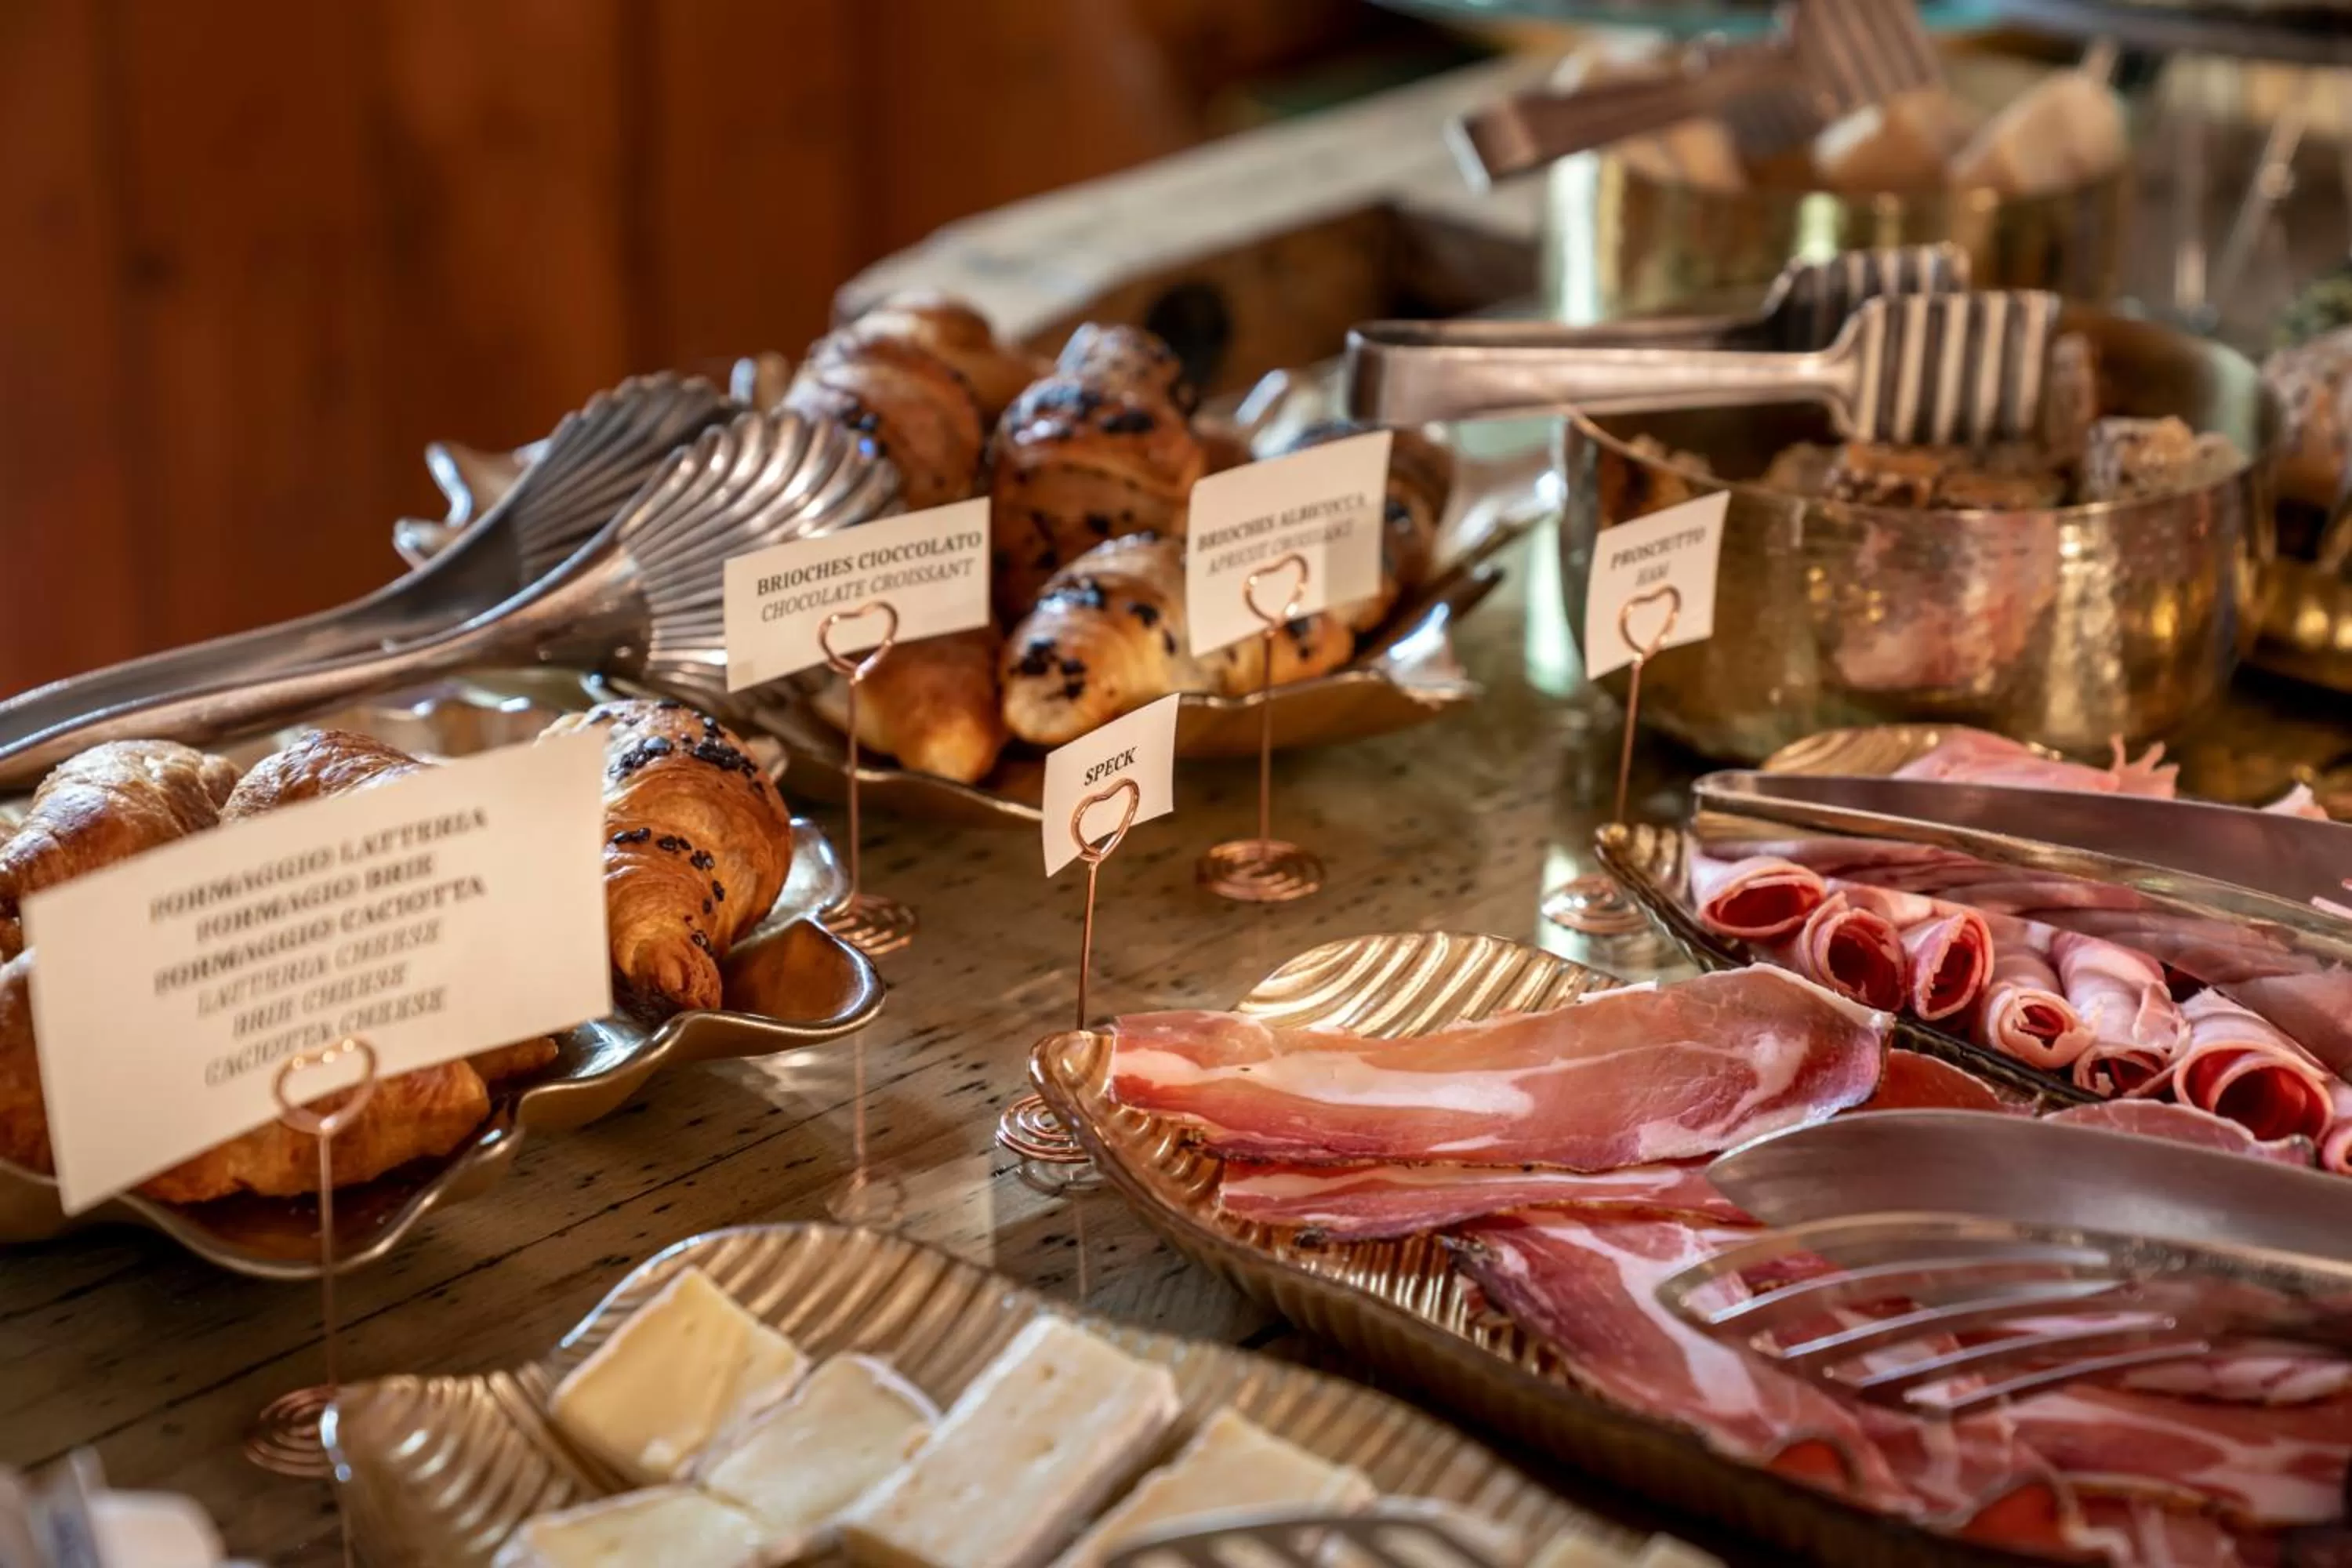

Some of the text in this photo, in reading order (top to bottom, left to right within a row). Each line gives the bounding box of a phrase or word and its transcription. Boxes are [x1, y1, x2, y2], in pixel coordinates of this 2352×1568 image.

[757, 531, 983, 596] BRIOCHES CIOCCOLATO
[1196, 514, 1276, 552] BRIOCHES
[761, 557, 975, 622] CHOCOLATE CROISSANT
[1083, 745, 1138, 786] SPECK
[148, 808, 488, 924] FORMAGGIO LATTERIA
[364, 853, 436, 893] BRIE
[153, 874, 487, 996] FORMAGGIO CACIOTTA
[198, 916, 443, 1018] LATTERIA CHEESE
[232, 960, 408, 1041] BRIE CHEESE
[338, 985, 448, 1036] CHEESE
